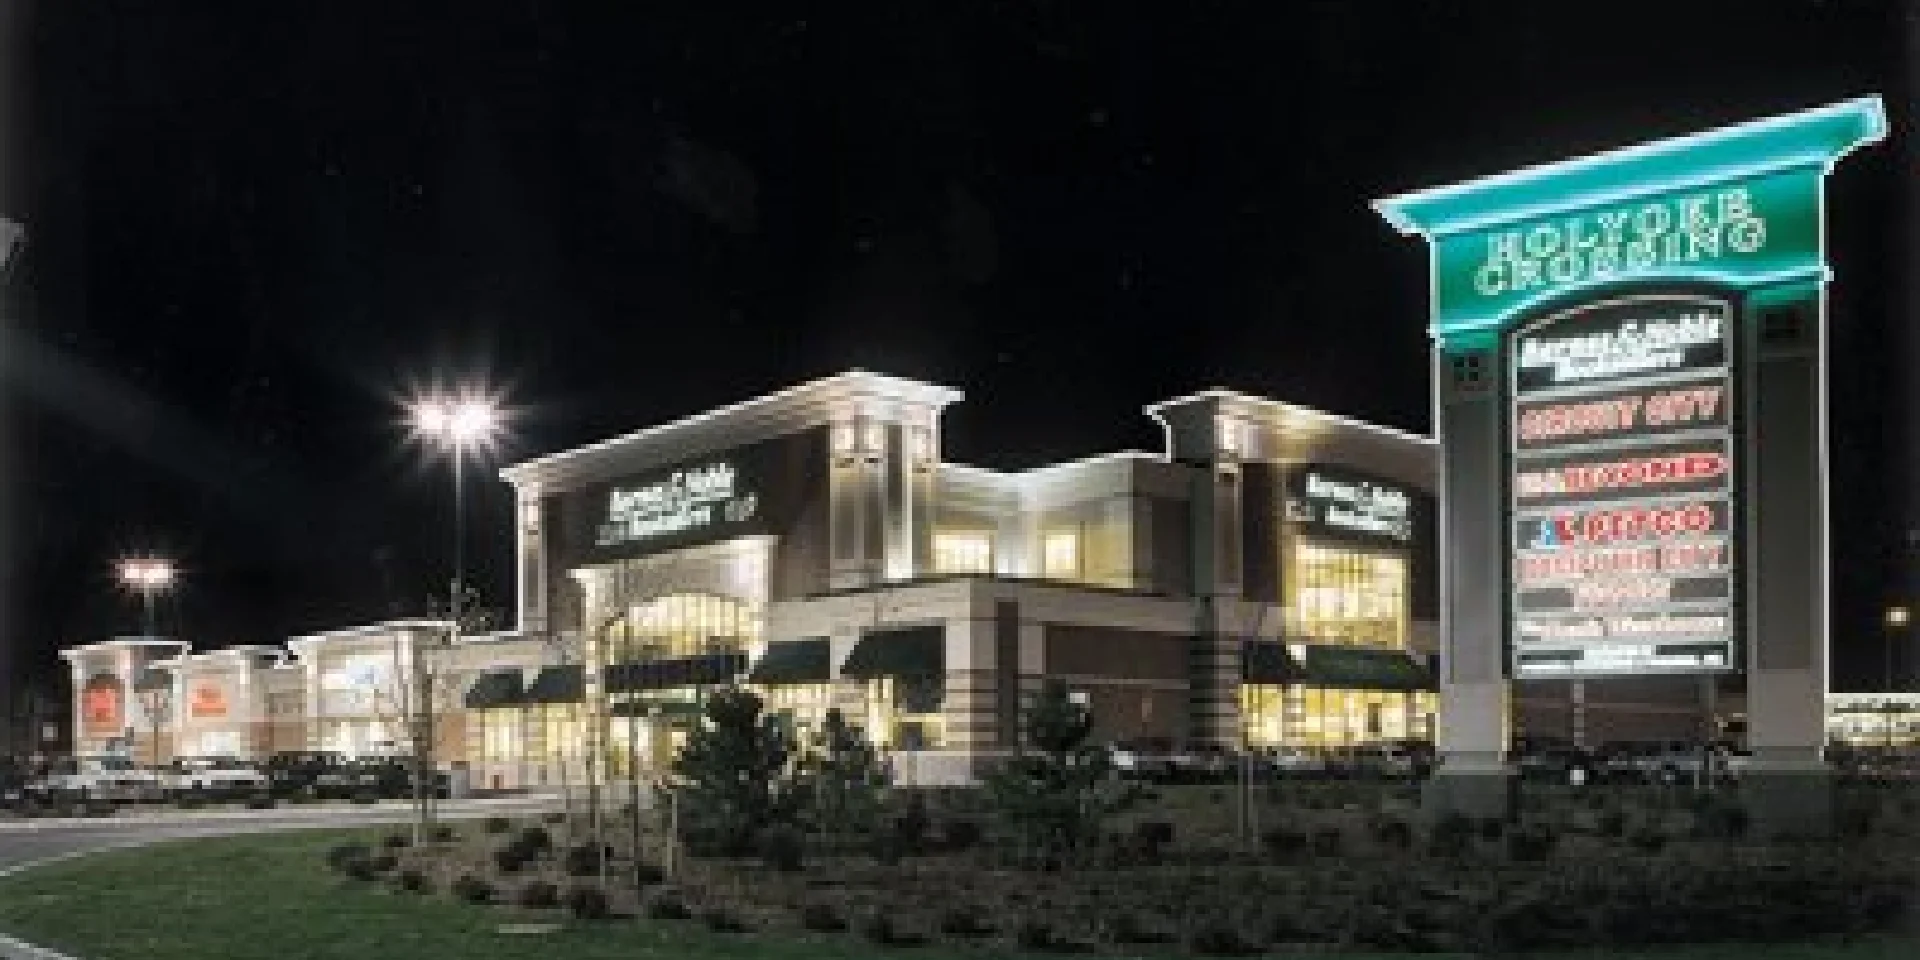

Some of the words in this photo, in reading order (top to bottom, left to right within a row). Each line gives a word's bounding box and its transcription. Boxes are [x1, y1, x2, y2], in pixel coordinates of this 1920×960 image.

[1474, 218, 1767, 297] CROSSING
[1488, 189, 1752, 264] HOLYOKE
[1583, 505, 1711, 541] PETCO
